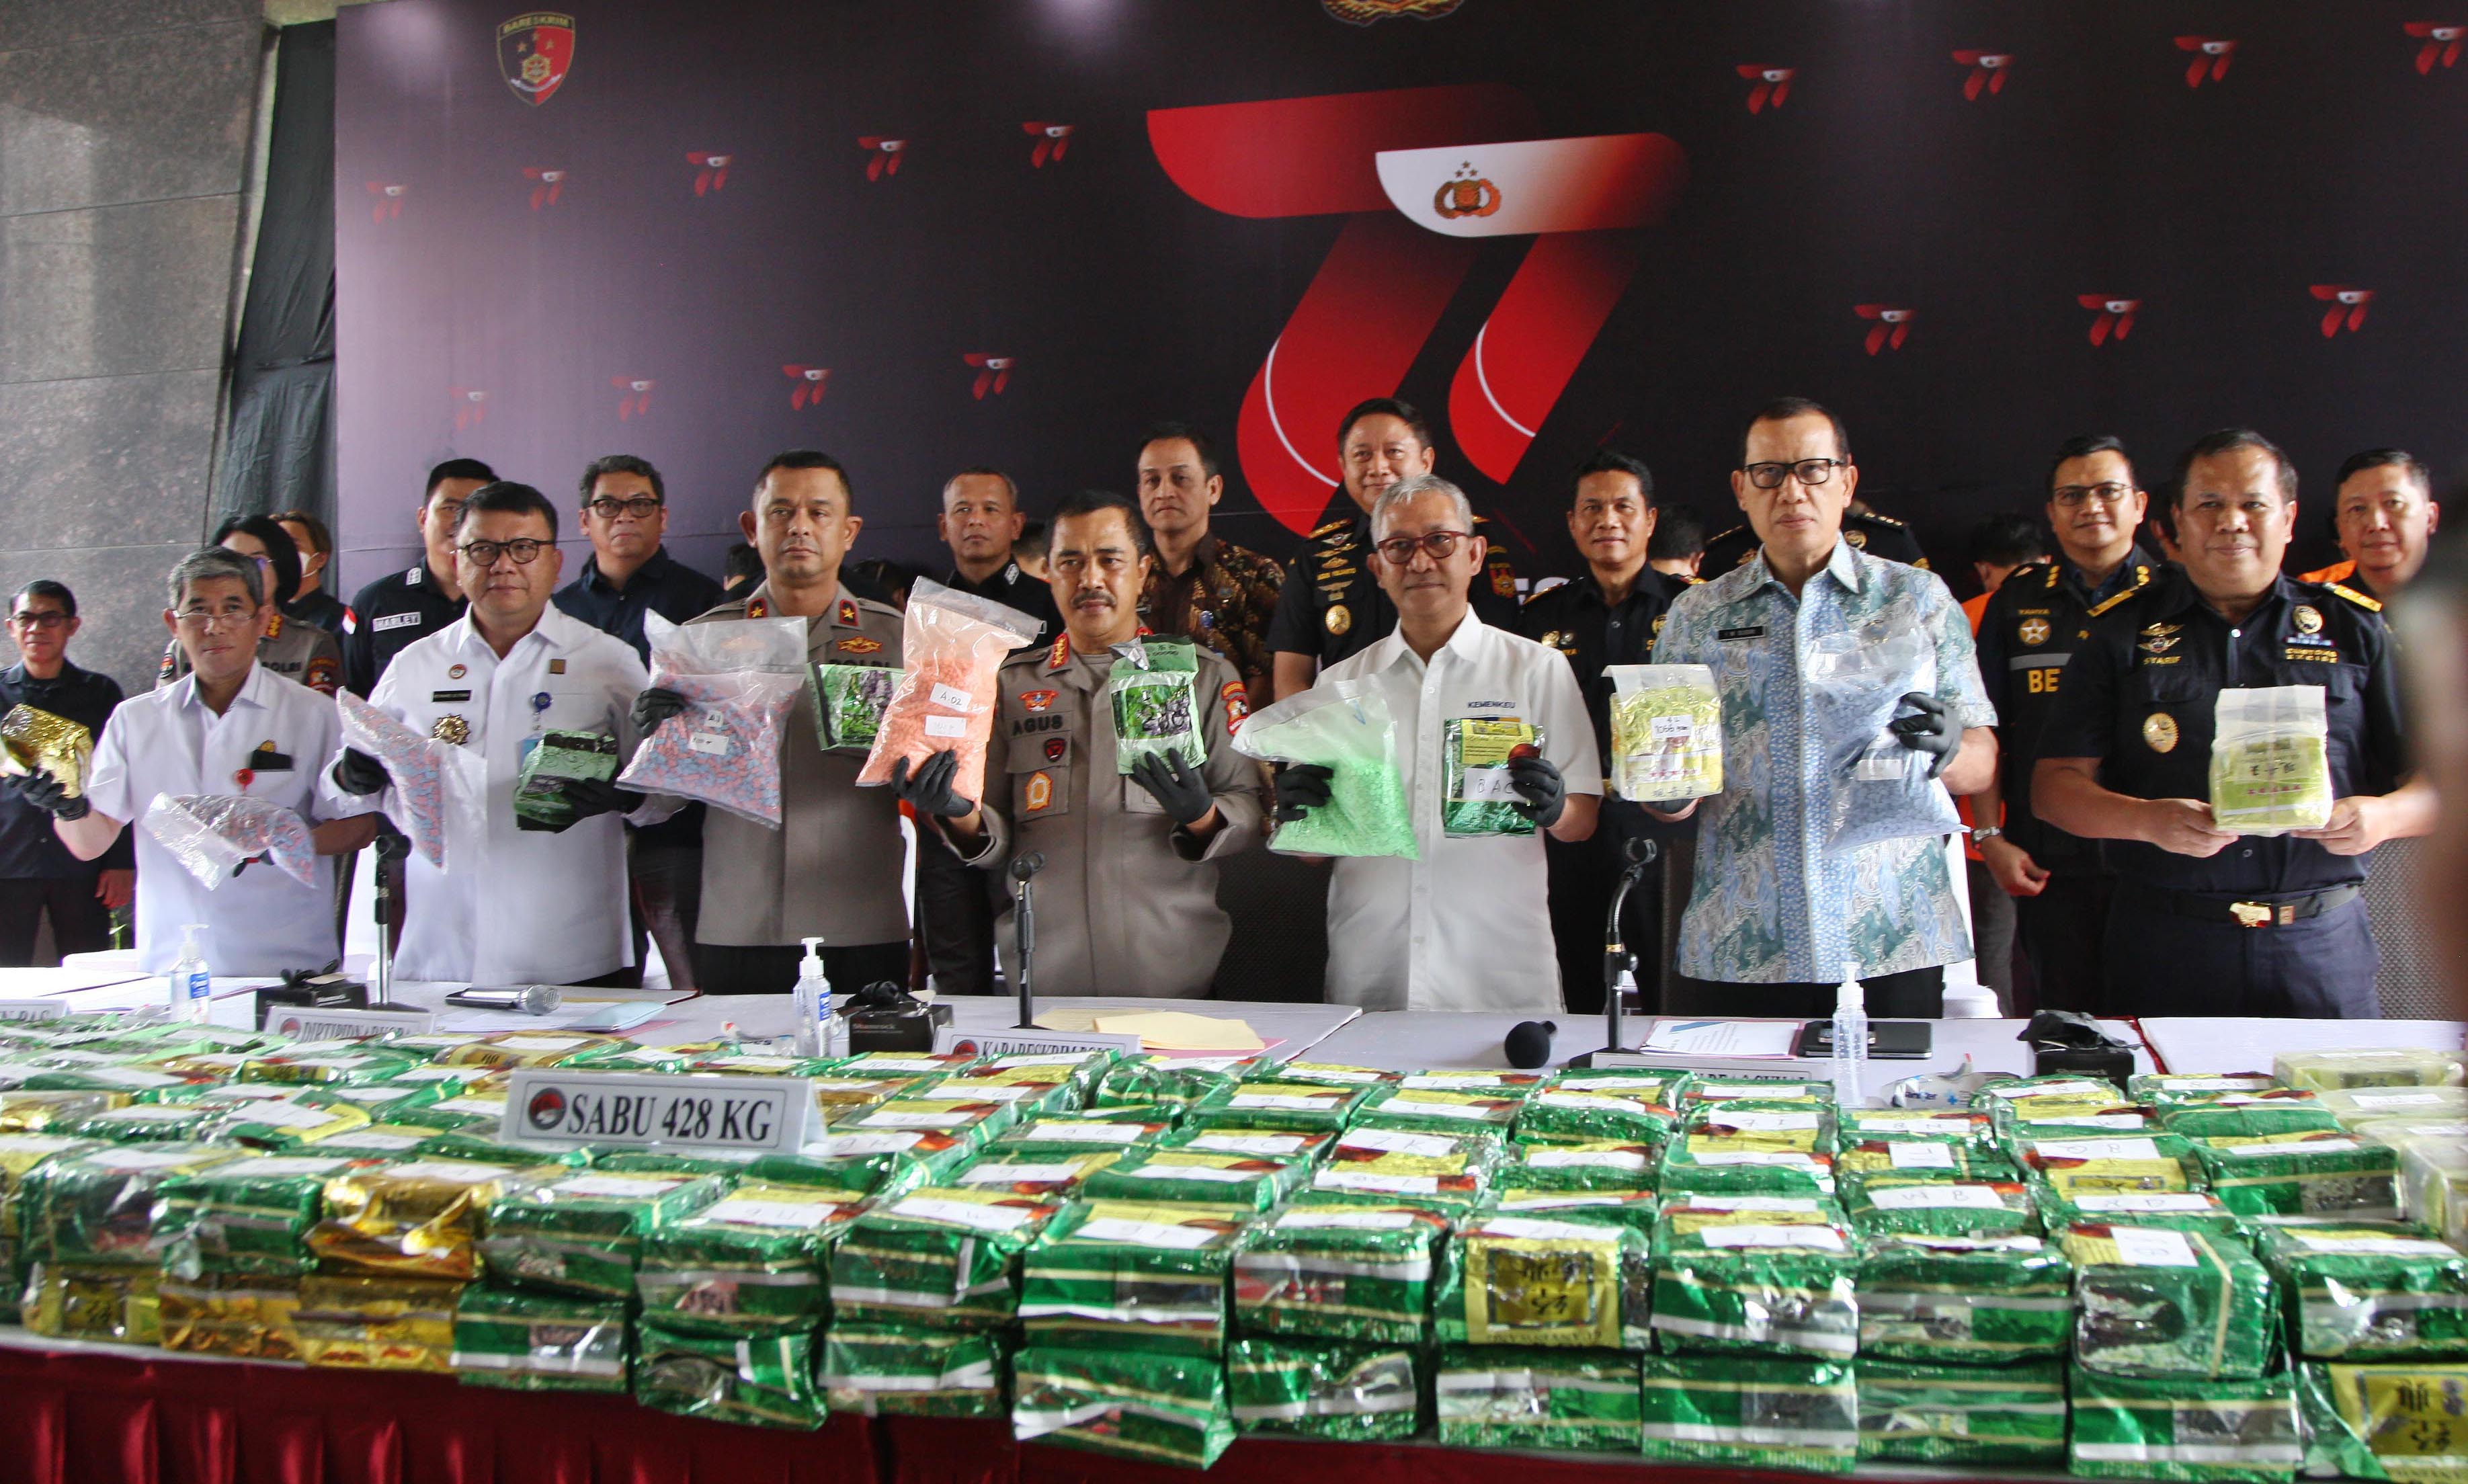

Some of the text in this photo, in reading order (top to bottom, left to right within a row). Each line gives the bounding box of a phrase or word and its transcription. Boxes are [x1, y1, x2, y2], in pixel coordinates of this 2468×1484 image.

[1012, 714, 1063, 736] AGUS
[567, 1093, 774, 1142] SABU 428 KG
